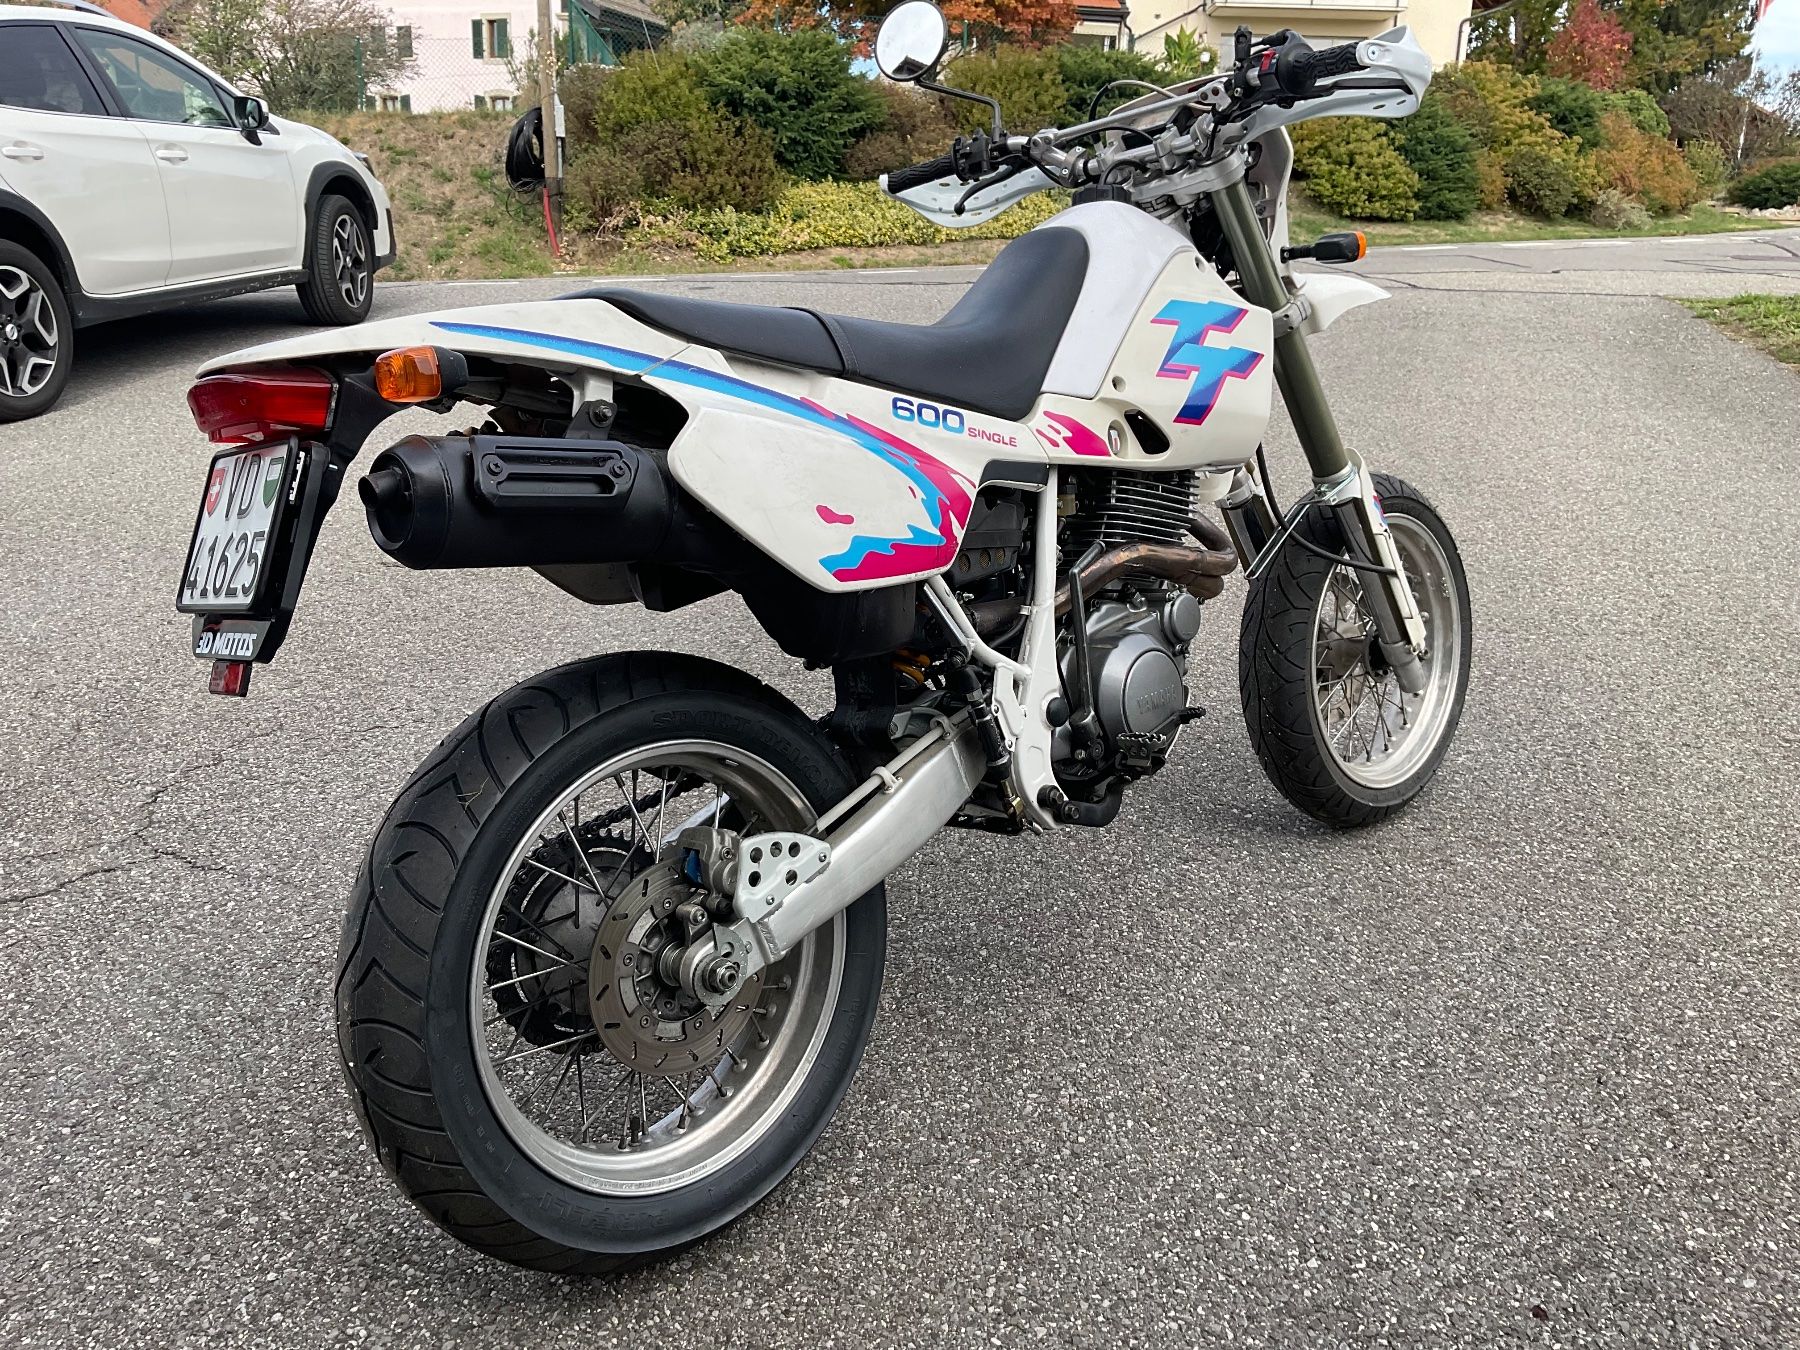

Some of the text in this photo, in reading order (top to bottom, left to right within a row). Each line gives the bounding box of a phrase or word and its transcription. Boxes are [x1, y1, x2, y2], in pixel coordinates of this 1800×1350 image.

[1150, 299, 1264, 425] TT
[891, 396, 1018, 448] 600 SINGLE
[224, 453, 262, 520] VD
[185, 530, 267, 600] 41625
[212, 632, 258, 657] MOTOS
[652, 709, 751, 734] SPORT
[1136, 684, 1177, 715] YAMAHA
